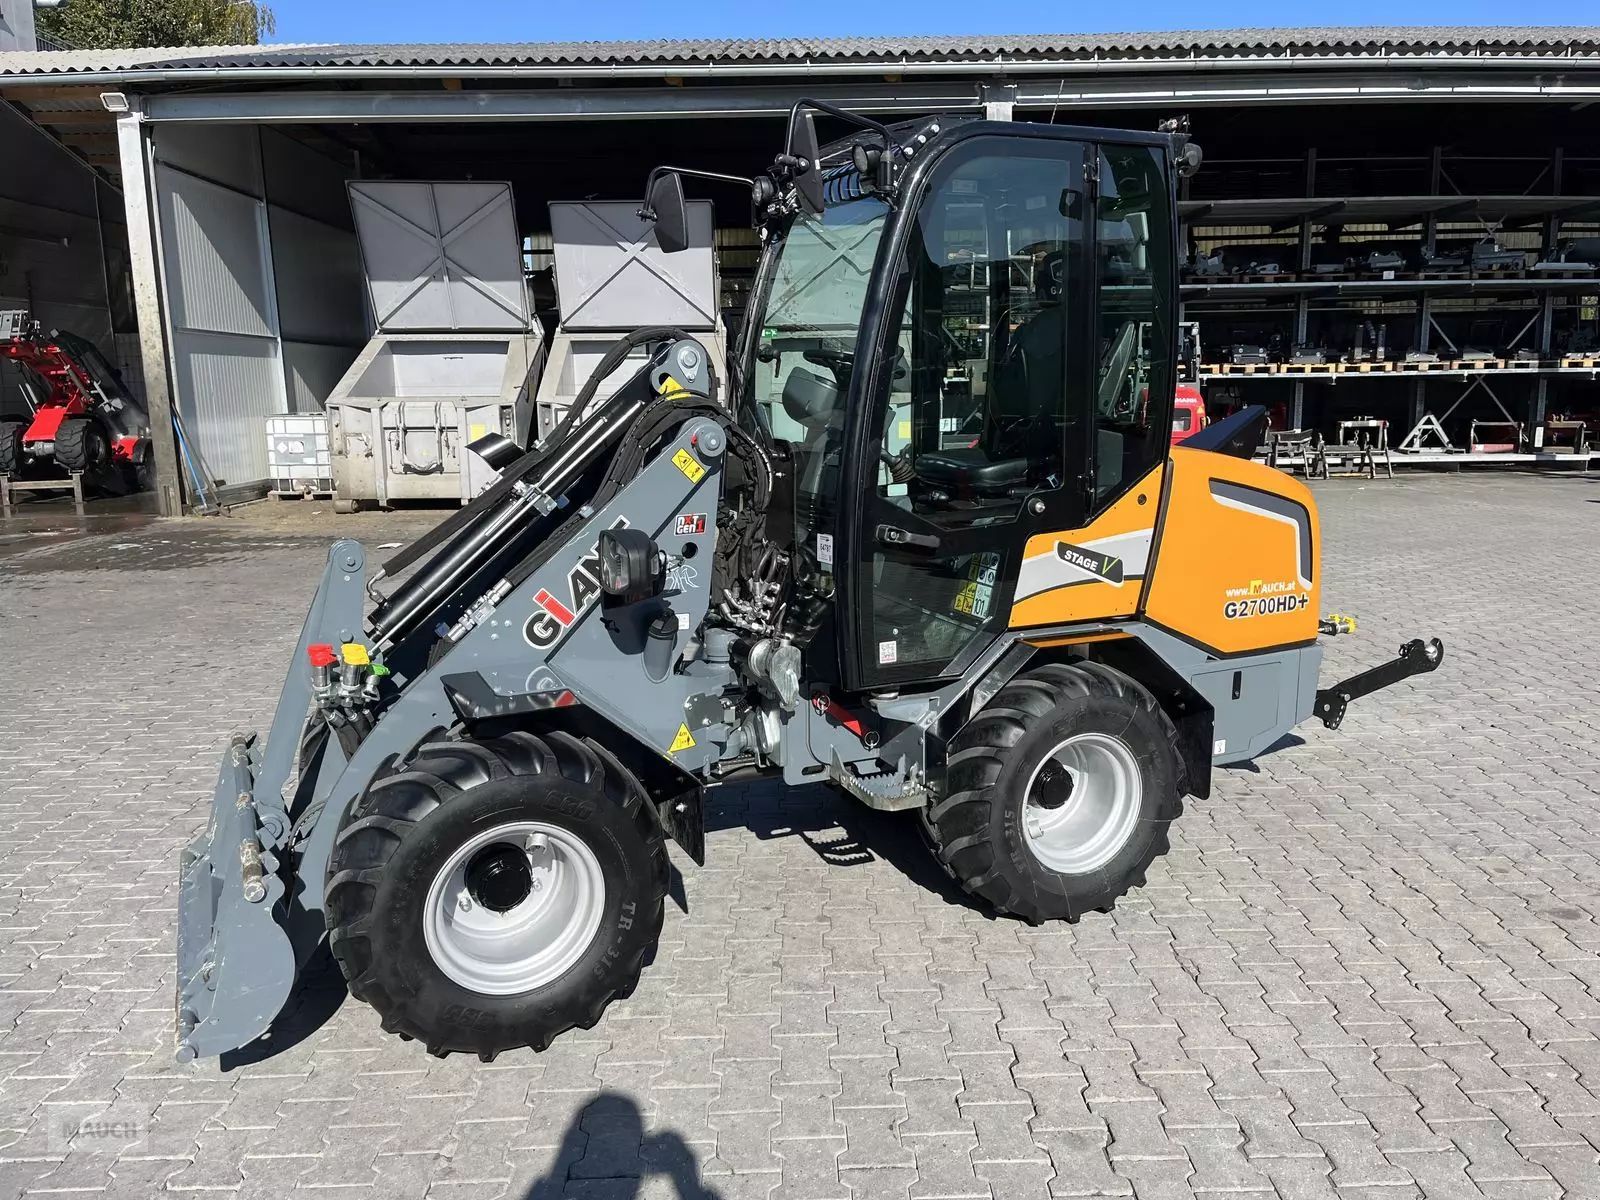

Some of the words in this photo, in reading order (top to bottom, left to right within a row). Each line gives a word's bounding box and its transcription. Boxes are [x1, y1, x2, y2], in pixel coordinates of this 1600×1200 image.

[1064, 550, 1098, 572] STAGE
[1101, 556, 1120, 575] V
[1226, 580, 1296, 597] www.MAUCH.at
[1223, 593, 1309, 620] G2700HD+
